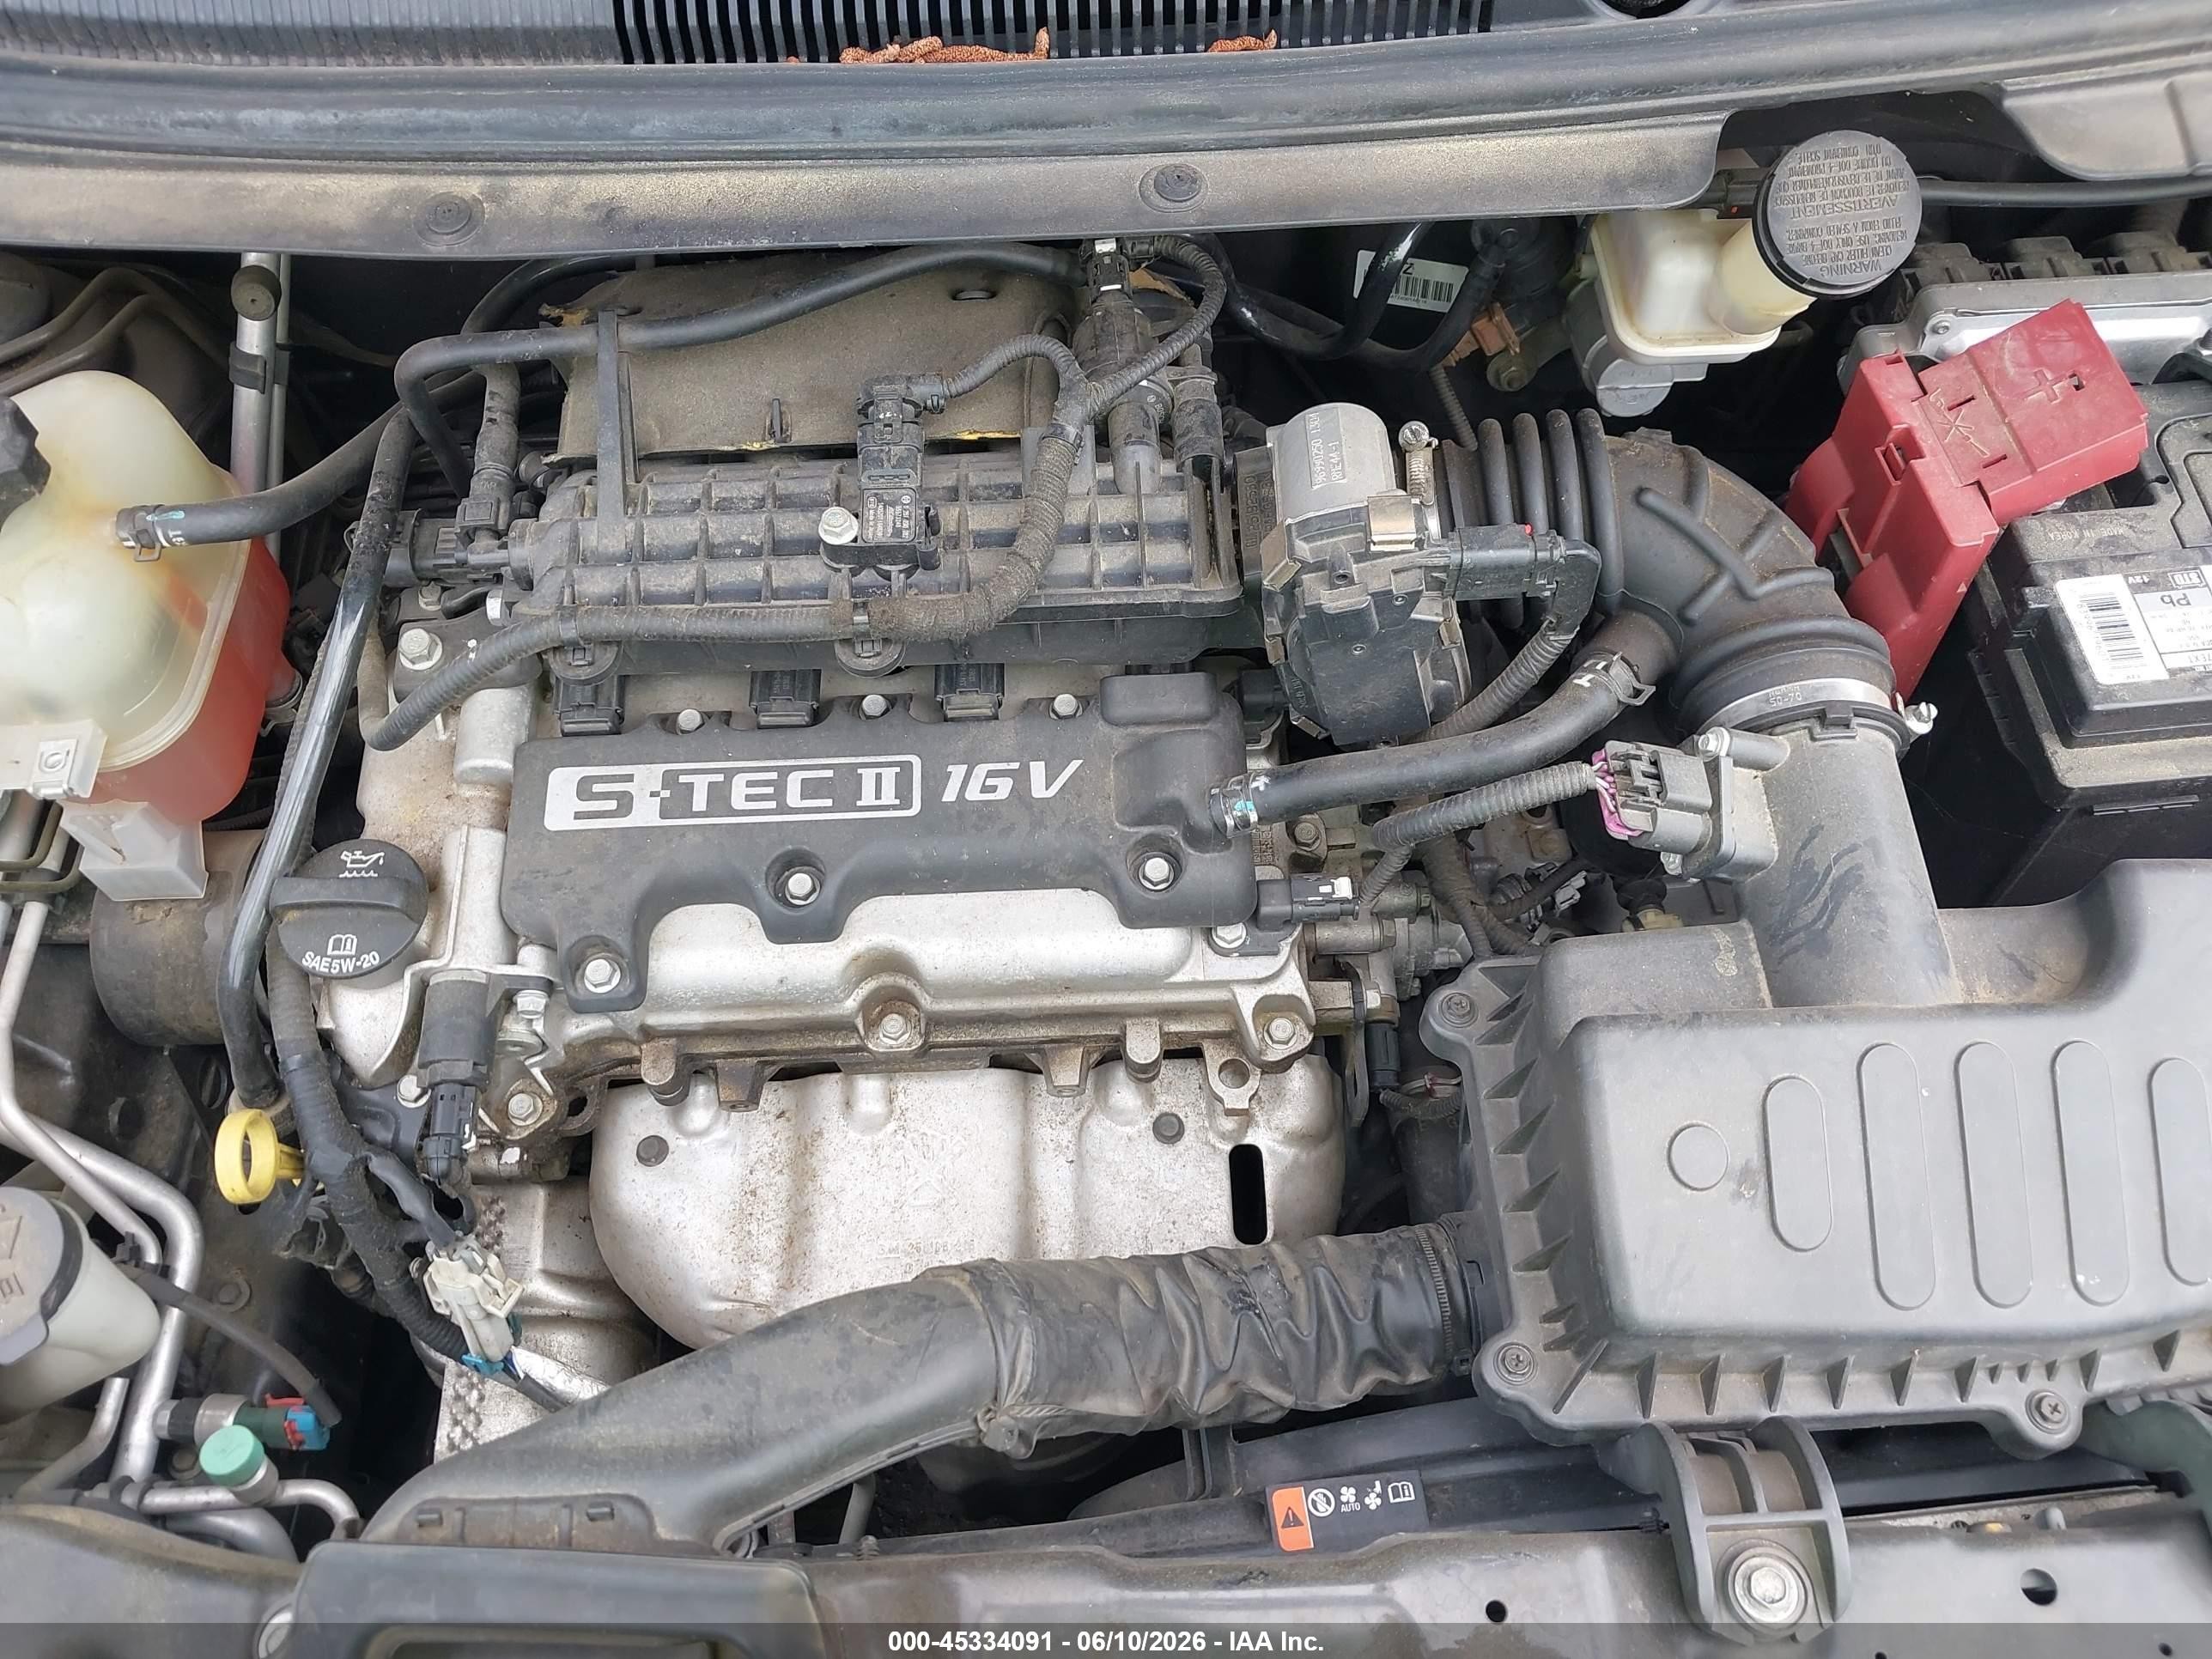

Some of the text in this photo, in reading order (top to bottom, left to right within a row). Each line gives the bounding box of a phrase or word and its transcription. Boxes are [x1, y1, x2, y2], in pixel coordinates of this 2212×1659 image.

[1790, 194, 1899, 220] AVERTISSEMENT
[1861, 220, 1880, 232] FROM
[1882, 217, 1901, 228] FLUID
[1826, 223, 1850, 236] SEALED
[1810, 240, 1832, 252] DOT-4
[1835, 237, 1853, 248] ONLY
[1856, 234, 1869, 246] USE
[1831, 251, 1844, 262] CAP
[1846, 248, 1869, 260] FILLER
[1871, 245, 1892, 257] CLEAN
[1820, 259, 1881, 278] WARNING
[2047, 529, 2081, 541] KOREA
[2127, 574, 2150, 585] 12V
[2160, 592, 2192, 607] Pb
[1769, 692, 1802, 707] 50-70
[1340, 1502, 1361, 1513] AUTO
